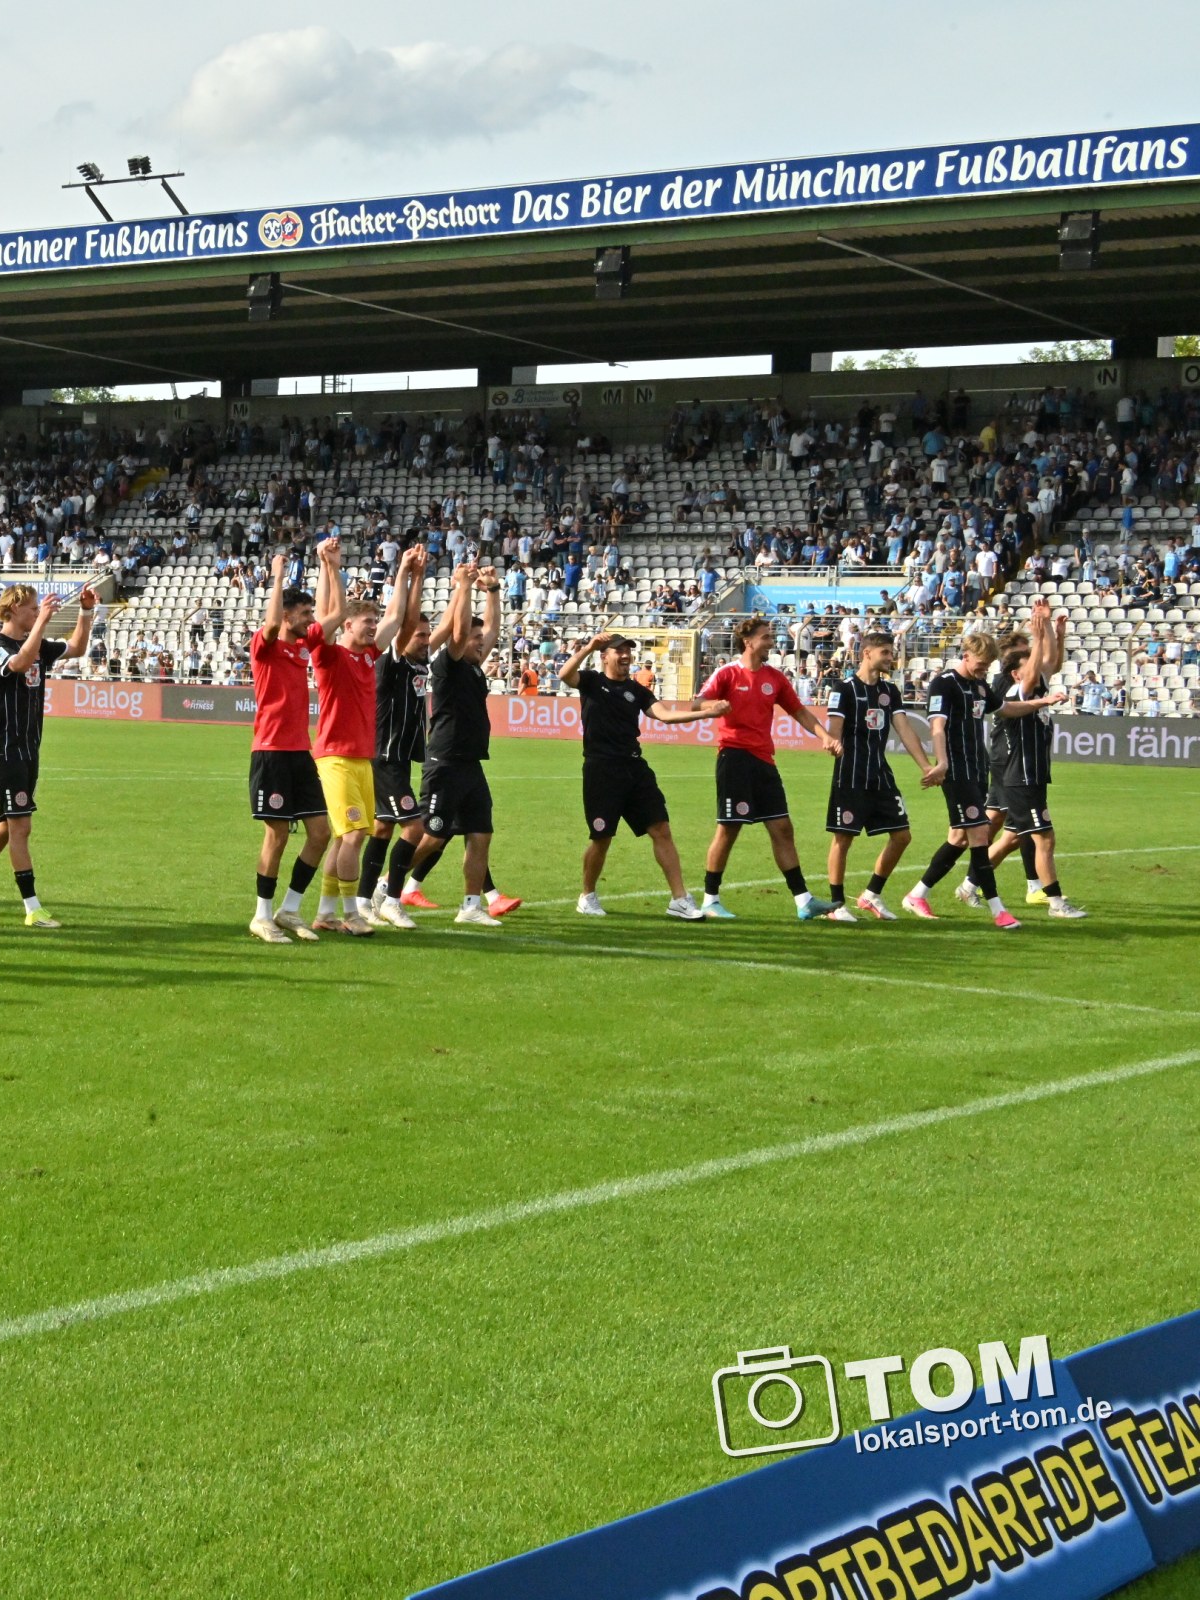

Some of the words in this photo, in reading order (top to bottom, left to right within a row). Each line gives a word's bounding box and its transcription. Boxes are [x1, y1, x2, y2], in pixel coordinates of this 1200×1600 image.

[310, 199, 500, 244] Hacker-Pschorr
[511, 188, 571, 224] Das
[580, 182, 651, 219] Bier
[660, 173, 723, 212] der
[731, 159, 926, 207] Münchner
[935, 132, 1190, 185] Fußballfans
[84, 219, 249, 260] Fußballfans
[1103, 368, 1117, 385] N
[74, 682, 143, 718] Dialog
[235, 698, 257, 712] NÄH
[508, 696, 583, 735] Dialo
[508, 725, 561, 735] Versicherungen
[1106, 1403, 1200, 1496] TEA
